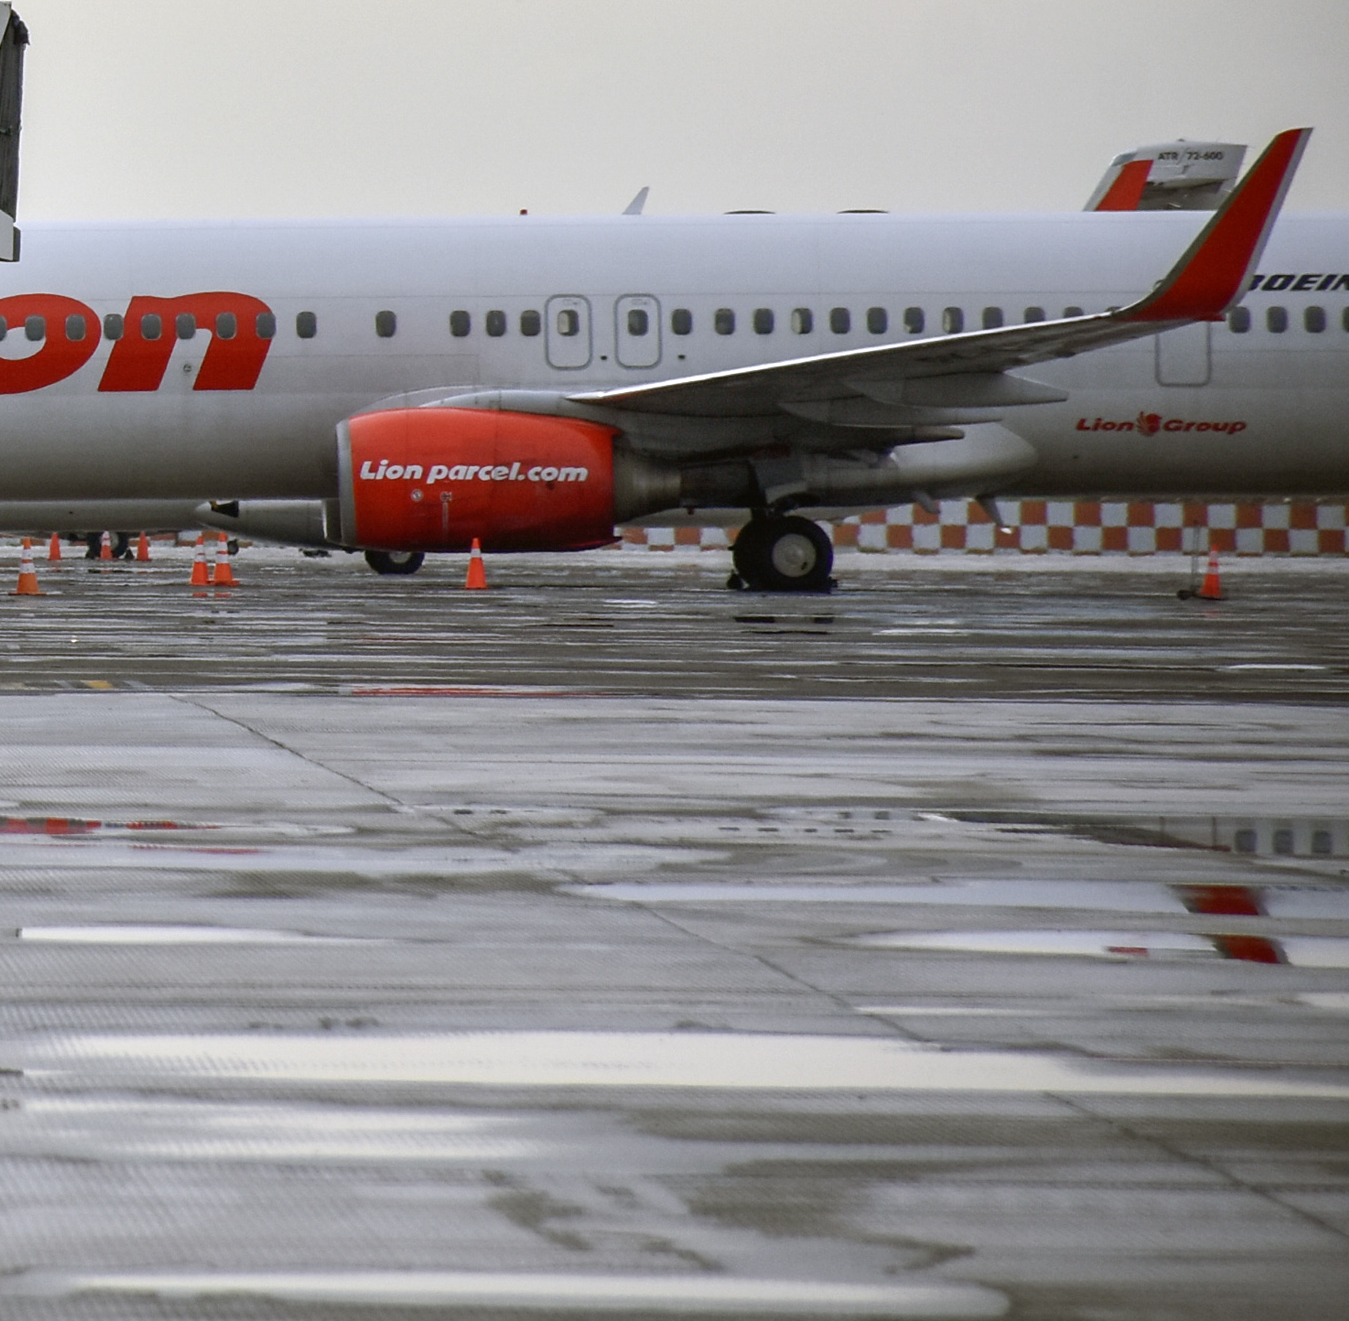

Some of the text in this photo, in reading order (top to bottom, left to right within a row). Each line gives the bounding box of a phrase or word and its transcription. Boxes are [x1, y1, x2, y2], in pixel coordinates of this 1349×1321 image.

[1158, 151, 1179, 161] ATR
[1076, 417, 1248, 435] Lion Group
[359, 459, 589, 485] Lion parcel.com
